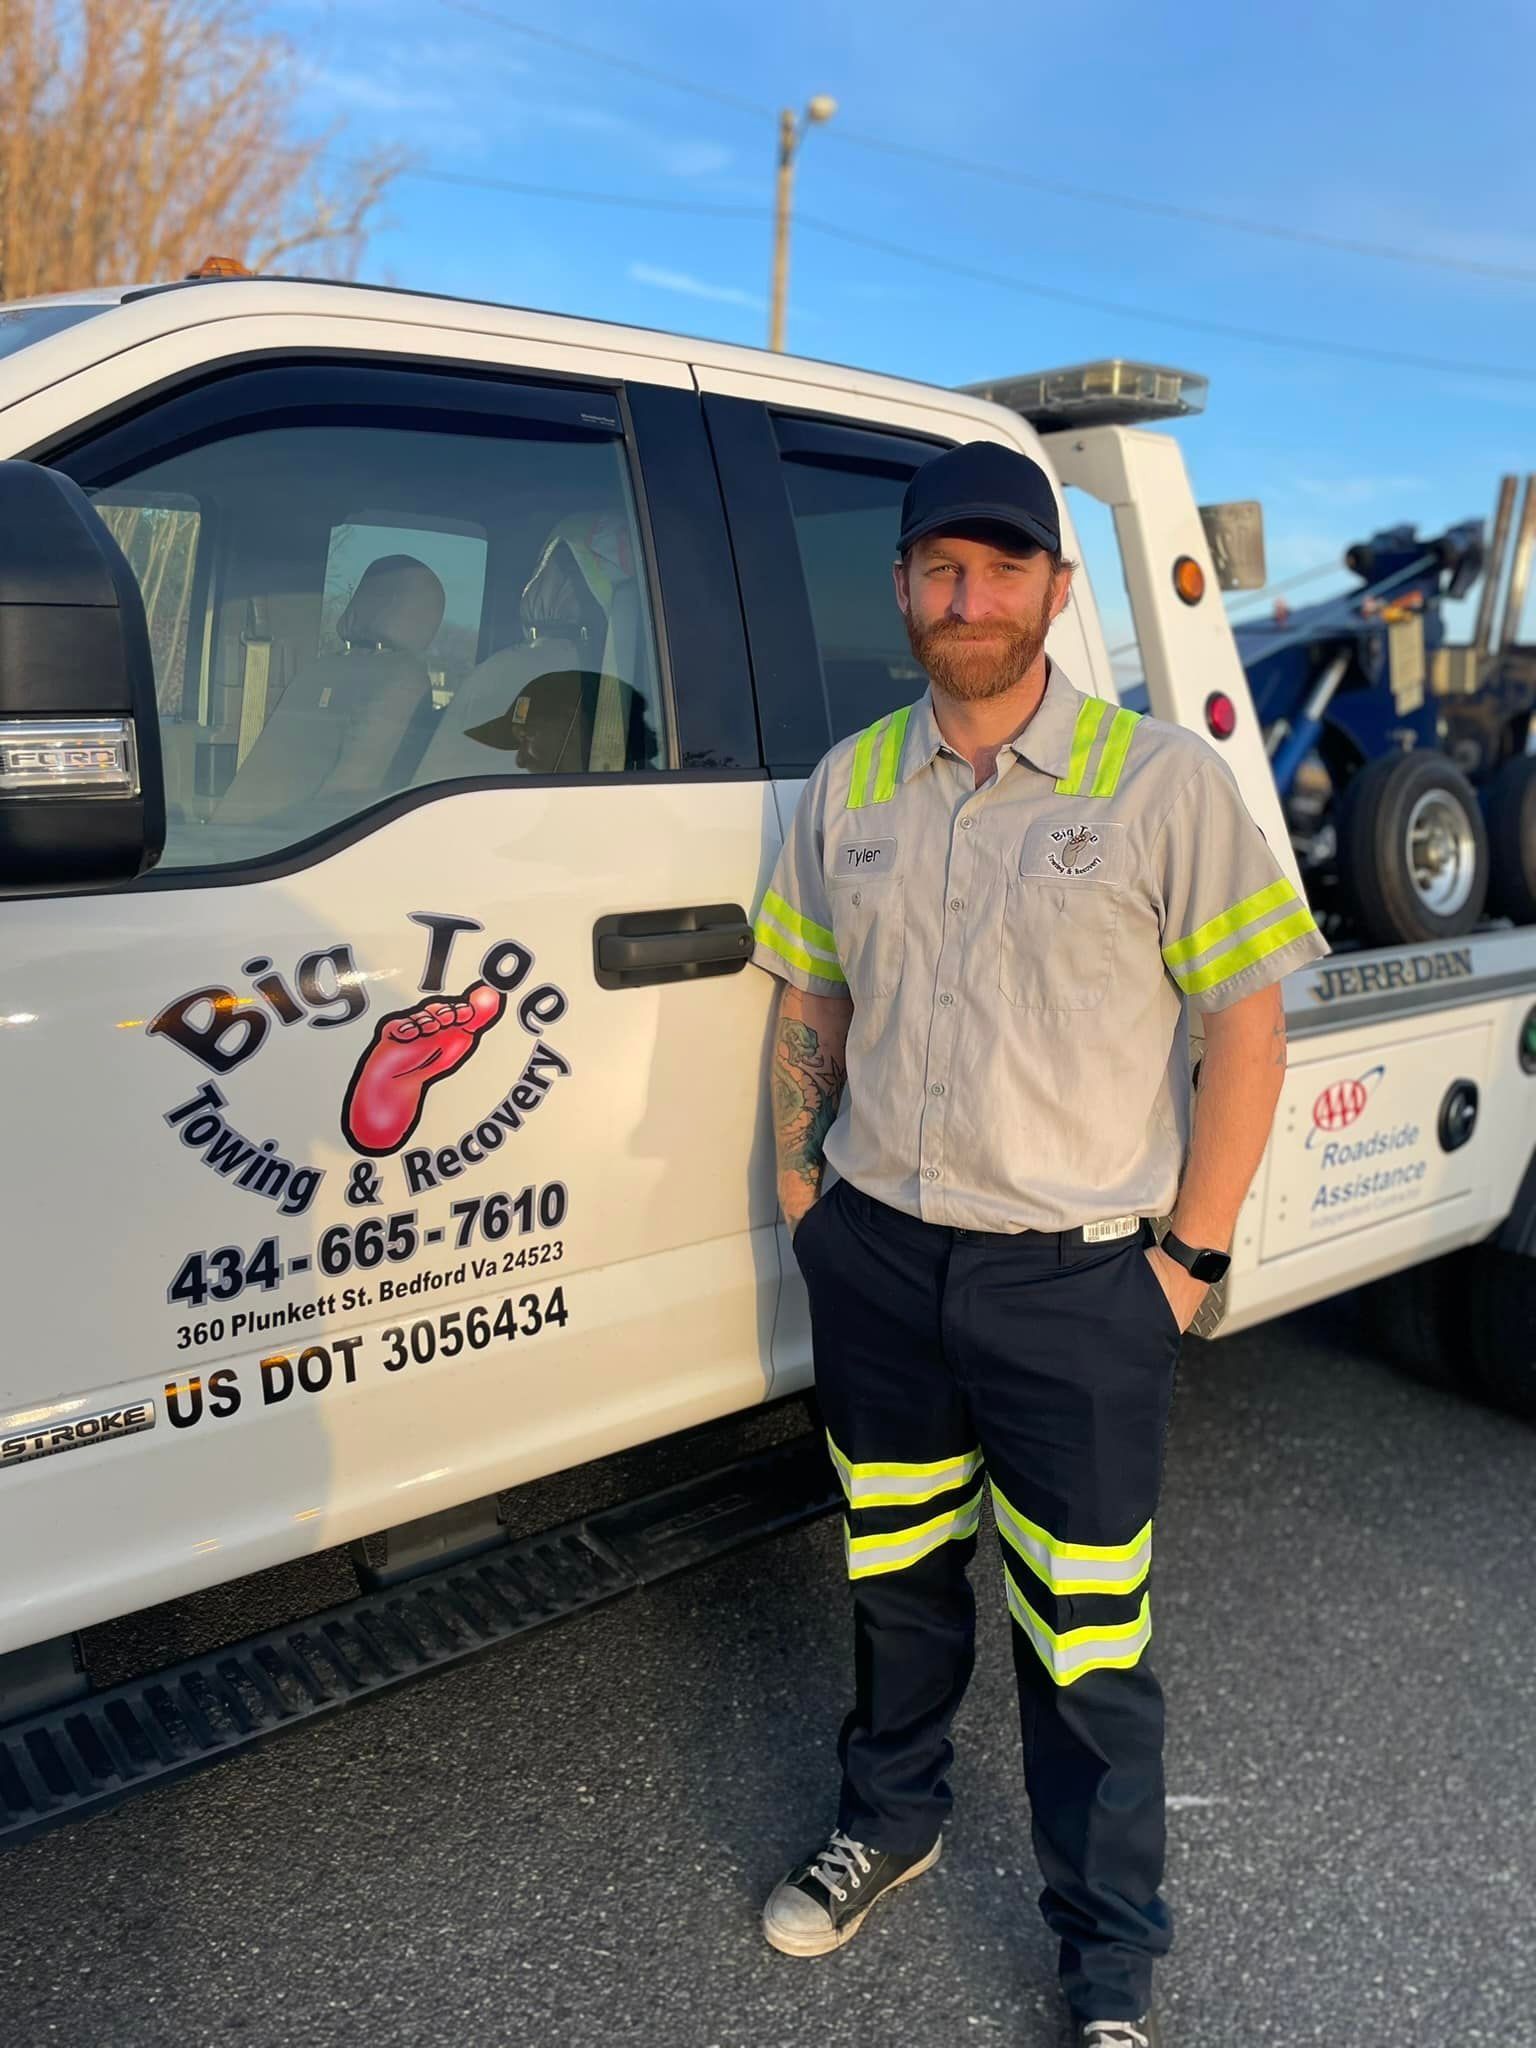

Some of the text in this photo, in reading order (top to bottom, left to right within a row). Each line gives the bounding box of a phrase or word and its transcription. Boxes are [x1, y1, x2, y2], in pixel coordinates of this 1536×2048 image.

[847, 848, 881, 867] Tyler
[1051, 825, 1099, 843] Big Te
[146, 911, 569, 1075] Big Toe
[163, 1038, 572, 1217] Towing & Recovery
[1321, 1124, 1419, 1169] Roadside
[1311, 1160, 1426, 1211] Assistance
[176, 1241, 564, 1350] 360 Plunkett St. Bedford Va 24523
[164, 1286, 569, 1429] US DOT 3056434
[2, 1405, 146, 1459] STROKE
